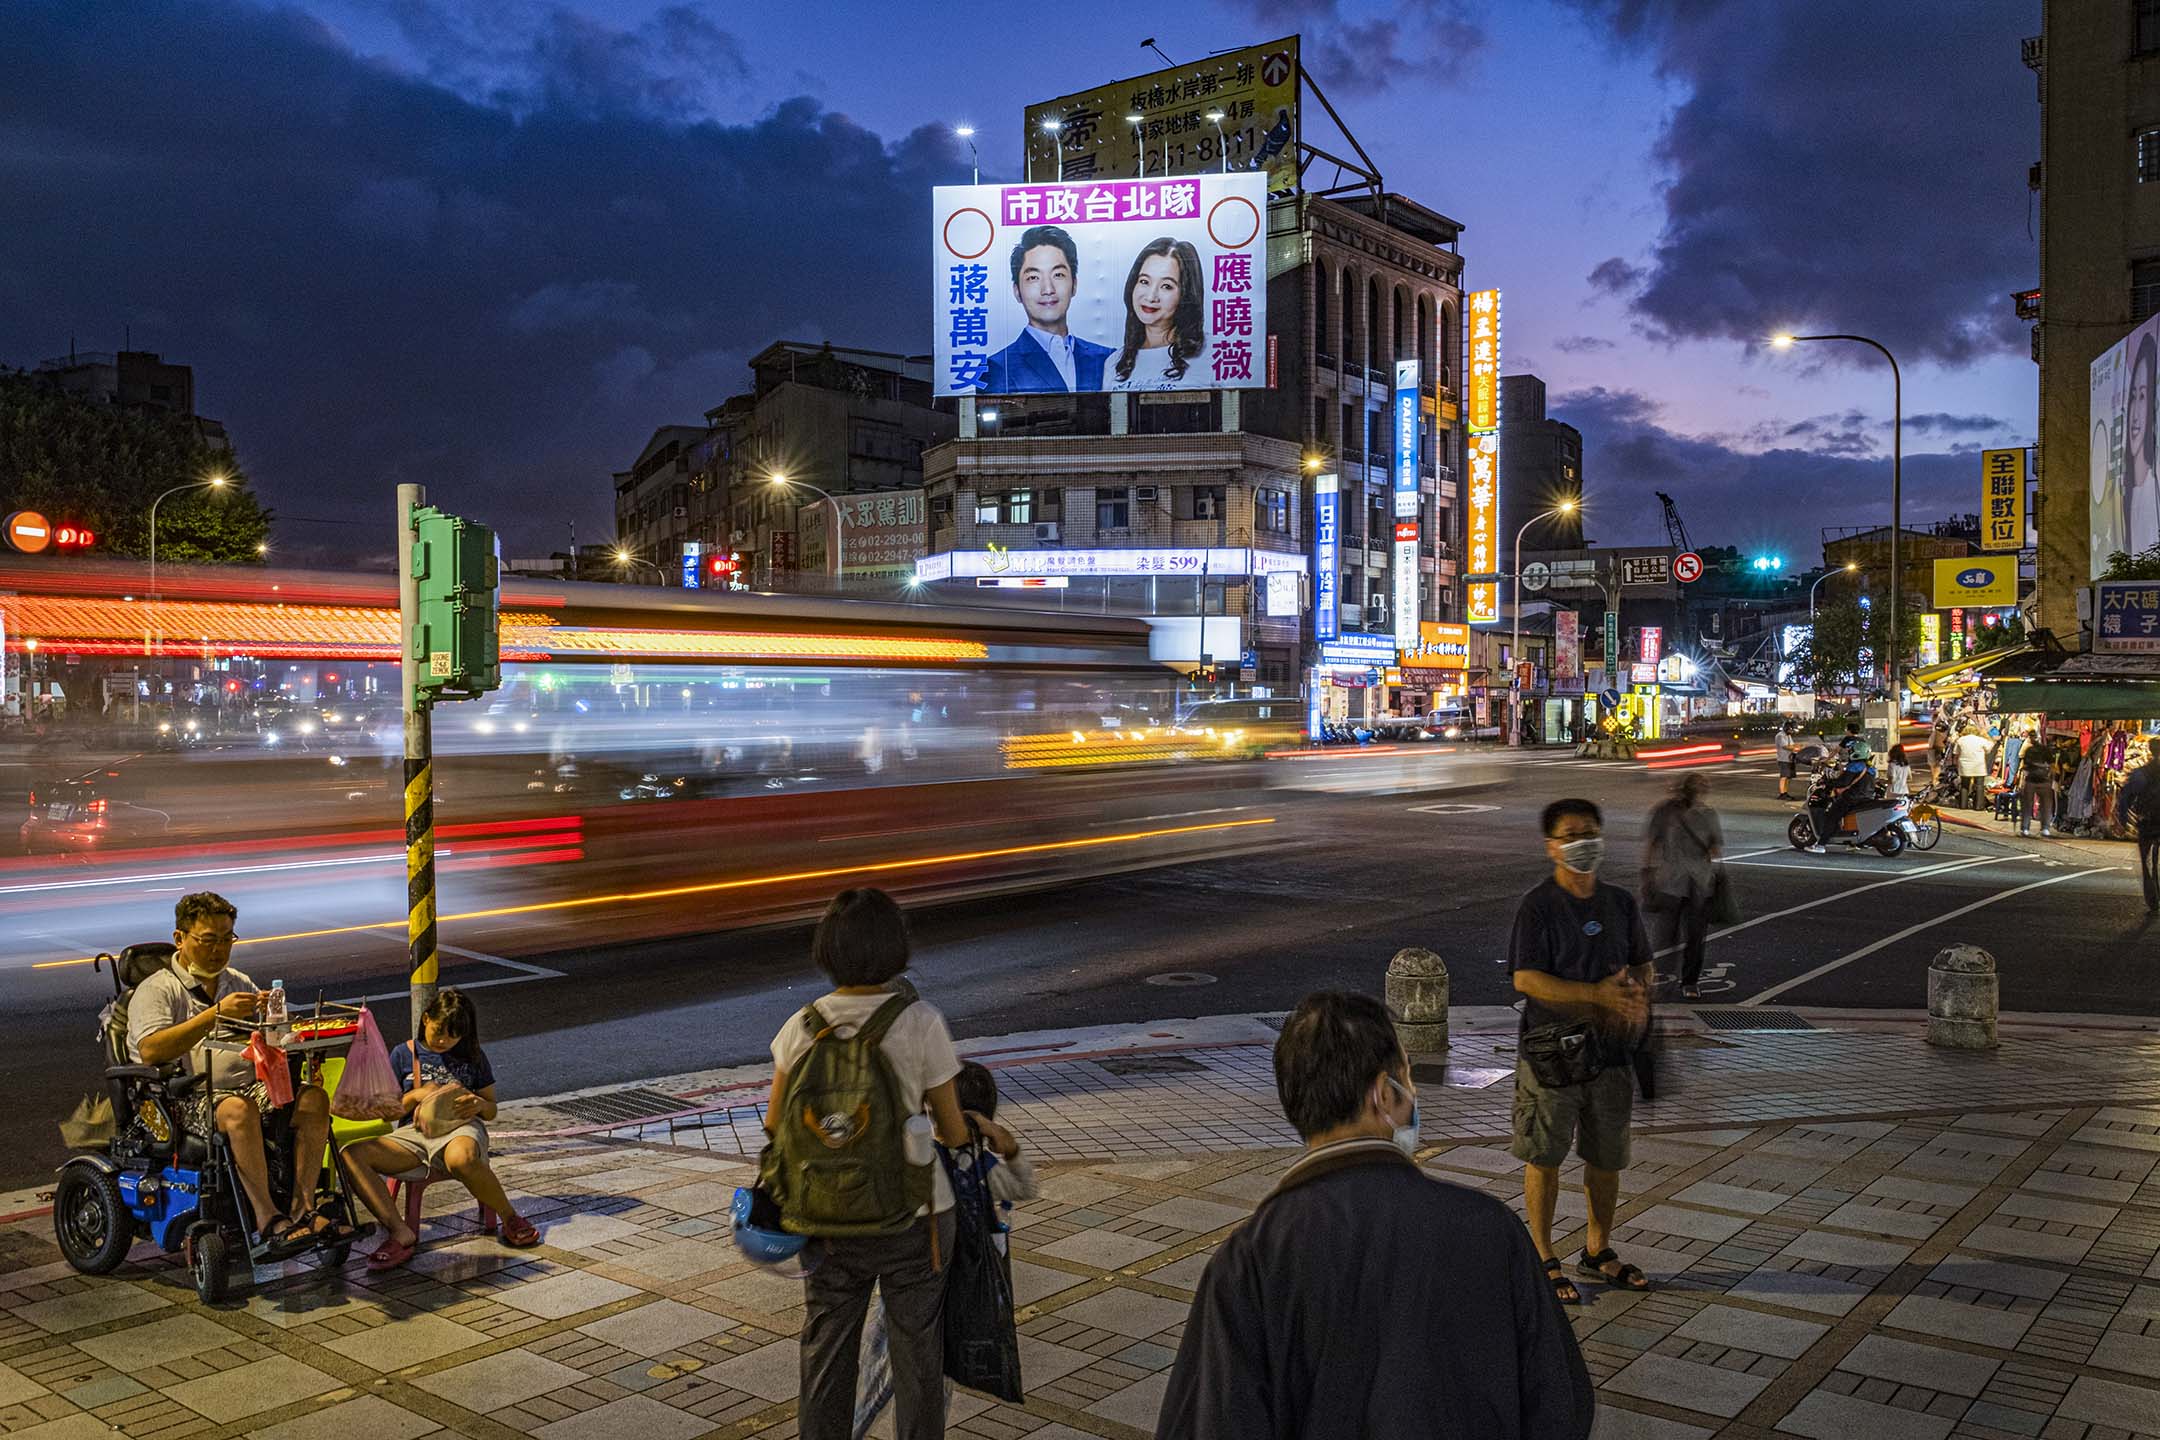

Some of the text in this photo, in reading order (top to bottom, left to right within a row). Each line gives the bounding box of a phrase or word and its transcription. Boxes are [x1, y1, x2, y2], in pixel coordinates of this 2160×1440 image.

[1130, 63, 1255, 112] 板橋水岸第一排
[1007, 183, 1196, 224] 市政台北隊
[949, 263, 989, 391] 蔣萬安
[1211, 252, 1253, 381] 應曉薇
[1990, 453, 2016, 541] 全聯數位
[1136, 556, 1199, 571] 染髮 599
[1471, 456, 1494, 617] 萬華身心精神診所
[2103, 590, 2160, 610] 大尺碼
